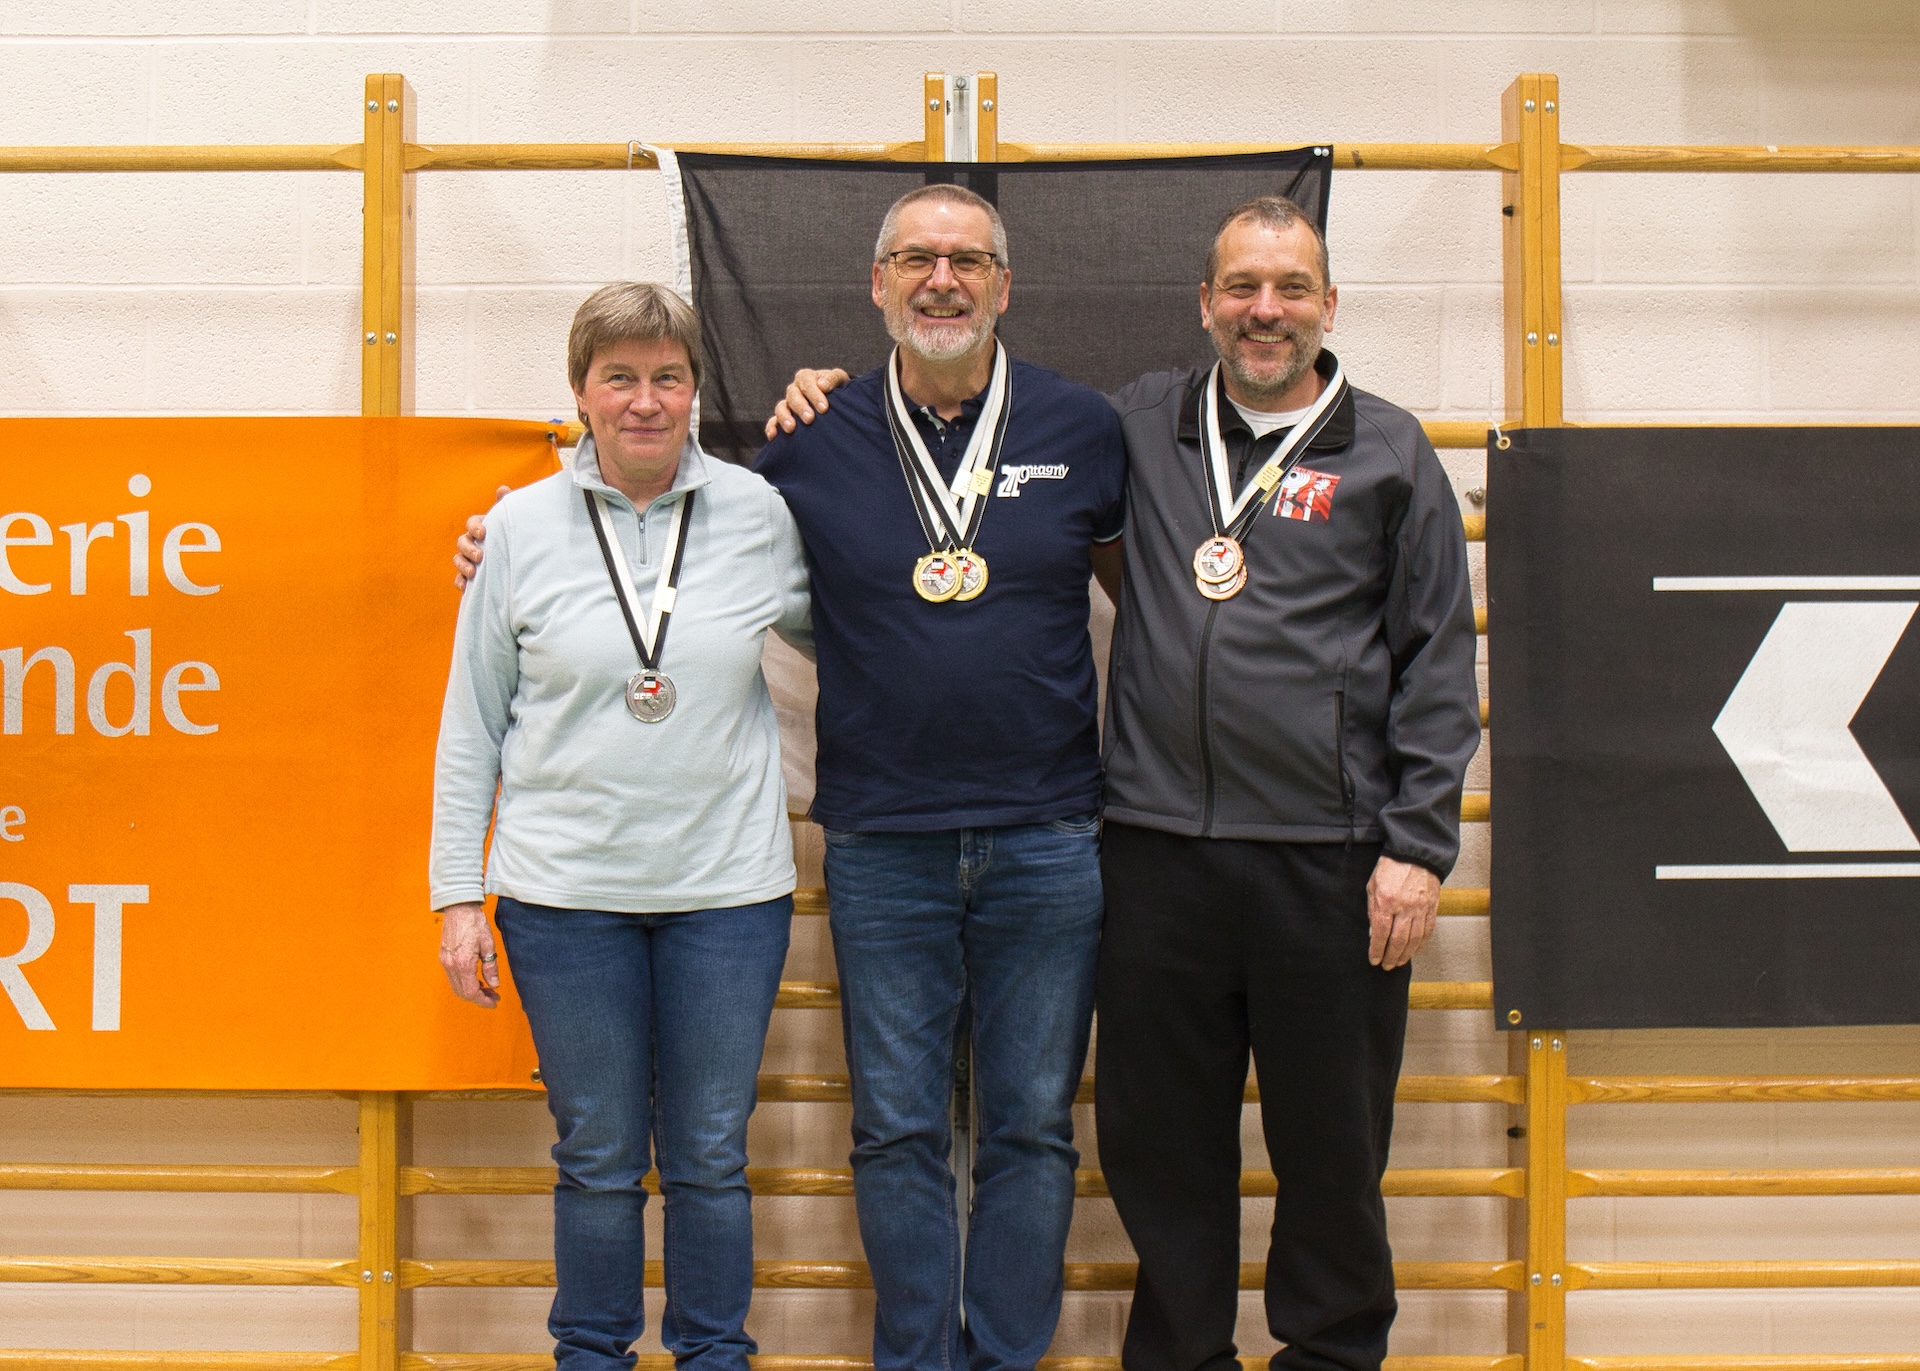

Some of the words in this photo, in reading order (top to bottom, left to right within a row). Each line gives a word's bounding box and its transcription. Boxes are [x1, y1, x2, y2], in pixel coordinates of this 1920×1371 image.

[0, 474, 221, 596] erie
[0, 628, 220, 737] nde
[0, 882, 149, 1031] RT
